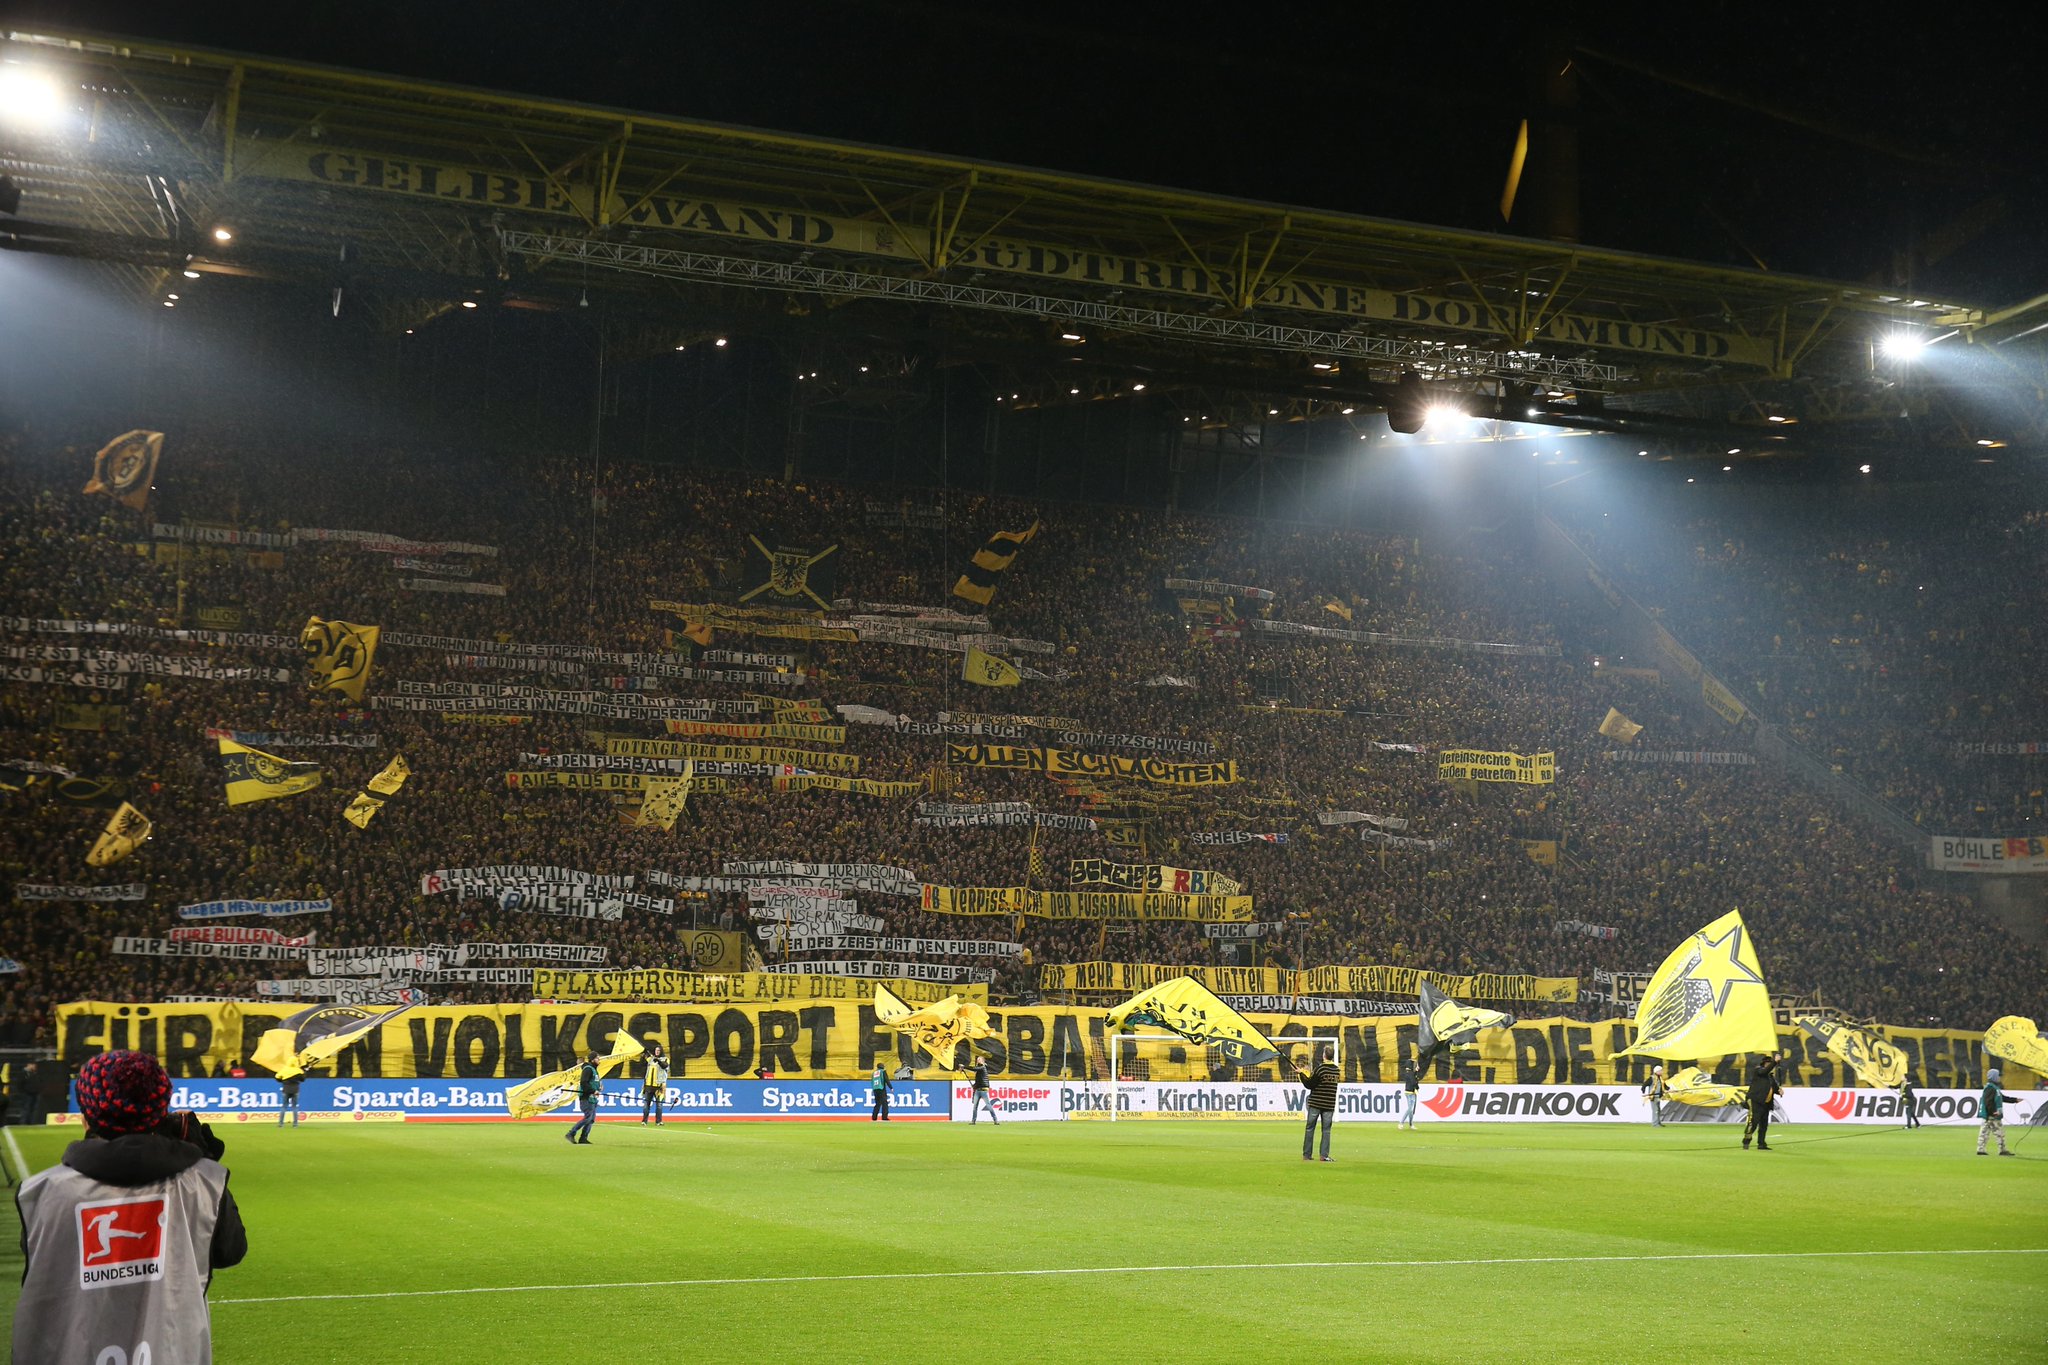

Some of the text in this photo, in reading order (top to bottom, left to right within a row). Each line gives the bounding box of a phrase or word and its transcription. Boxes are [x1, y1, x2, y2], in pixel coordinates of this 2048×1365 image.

[309, 152, 571, 211] GELBE
[617, 193, 834, 243] WAND
[0, 617, 22, 632] ED
[30, 620, 67, 633] BULL
[188, 630, 218, 644] NUR
[225, 631, 263, 647] NOCH
[267, 635, 298, 650] SPO
[383, 631, 464, 651] RINDERWAHN
[484, 641, 532, 656] LEIPZIG
[630, 662, 684, 677] SCHEISS
[722, 670, 745, 683] RED
[377, 697, 425, 711] NICHT
[579, 702, 709, 721] VORSTANDSRAUM
[771, 724, 842, 741] RANGNICK
[896, 721, 1025, 738] VERPISST EUCH
[526, 754, 559, 767] WER
[562, 754, 590, 768] DEN
[595, 755, 674, 773] FUSSBALL
[611, 739, 840, 768] TOTENGRÄBER DES FUSSBALLS
[1439, 751, 1553, 770] Vereinsrechte mit FCK
[947, 745, 1232, 785] BULLEN SCHLACHTEN
[1438, 765, 1552, 783] Füßen getreten RB
[509, 773, 640, 789] RAUS AUS DER
[1193, 830, 1251, 844] SCHEIS
[728, 862, 913, 881] MINTZLAFF DU HURENSOHN!
[1071, 859, 1163, 890] SCHEISS
[1174, 869, 1211, 894] RB!
[649, 870, 692, 889] EURE
[699, 877, 763, 892] ELTERN
[822, 877, 920, 896] GESCHWIS
[513, 883, 578, 898] STATT
[584, 884, 671, 913] BRAUSE!
[765, 893, 855, 913] VERPISST EUCH
[924, 884, 940, 910] RB
[1078, 892, 1137, 918] FUSSBALL
[1197, 894, 1226, 921] UNS!
[180, 901, 225, 917] LIEBER
[270, 900, 305, 914] WEST
[753, 907, 776, 919] AUS
[840, 912, 878, 932] SPORT
[172, 927, 210, 942] EURE
[1209, 924, 1247, 937] FUCK
[122, 939, 160, 953] IHR
[166, 941, 213, 956] SEID
[220, 944, 261, 959] HIER
[268, 946, 318, 961] NICHT
[467, 944, 503, 959] DICH
[508, 944, 604, 962] MATESCHITZ!
[696, 935, 719, 958] BVB
[807, 936, 834, 950] DFB
[838, 936, 911, 952] ZERSTÖRT
[916, 939, 945, 953] DEN
[315, 954, 435, 975] BIER STATT RB
[804, 963, 840, 976] BULL
[845, 963, 868, 976] IST
[873, 964, 900, 978] DER
[389, 968, 471, 985] VERPISST
[477, 969, 516, 984] EUCH
[519, 969, 534, 984] IH
[535, 970, 846, 1001] PFLASTERSTEINE AUF DIE
[261, 980, 313, 995] RB IHR
[341, 989, 398, 1006] SCHEISS
[1222, 996, 1421, 1016] UPERFLOTT STATT BRAUSESCHR
[66, 1007, 218, 1078] FÜR
[243, 1014, 382, 1078] DN
[409, 1006, 835, 1079] VOLKSSPORT
[1512, 1026, 1597, 1086] DIE
[333, 1086, 508, 1112] Sparda-Ban
[956, 1086, 1051, 1099] Kibüheler
[1060, 1087, 1129, 1113] Brixen
[308, 1111, 340, 1120] POCO
[365, 1111, 397, 1120] POCO
[83, 1263, 159, 1284] BUNDESLIGA
